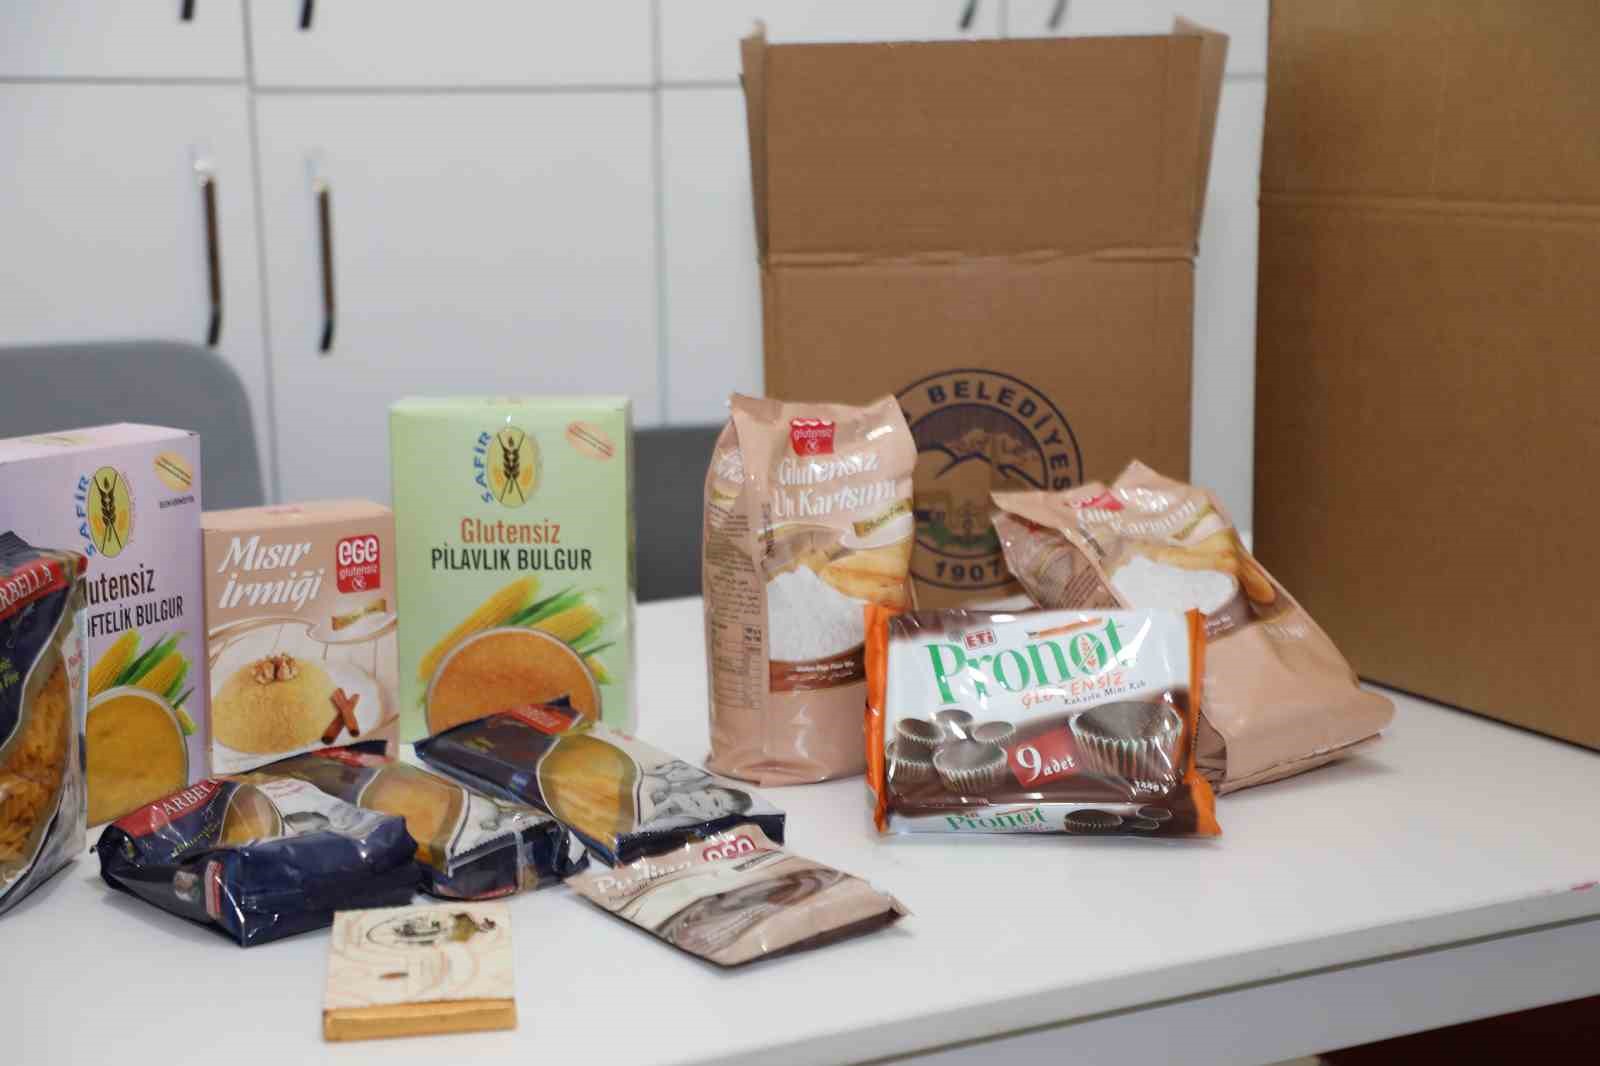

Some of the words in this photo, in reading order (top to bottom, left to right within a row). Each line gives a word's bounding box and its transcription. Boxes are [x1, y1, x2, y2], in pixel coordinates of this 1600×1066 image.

[460, 517, 561, 545] Glutensiz
[217, 535, 313, 573] Mısır
[431, 542, 511, 571] PİLAVLIK
[517, 548, 593, 571] BULGUR
[81, 563, 156, 606] lutensiz
[136, 595, 184, 627] BULGUR
[1016, 744, 1042, 781] 9
